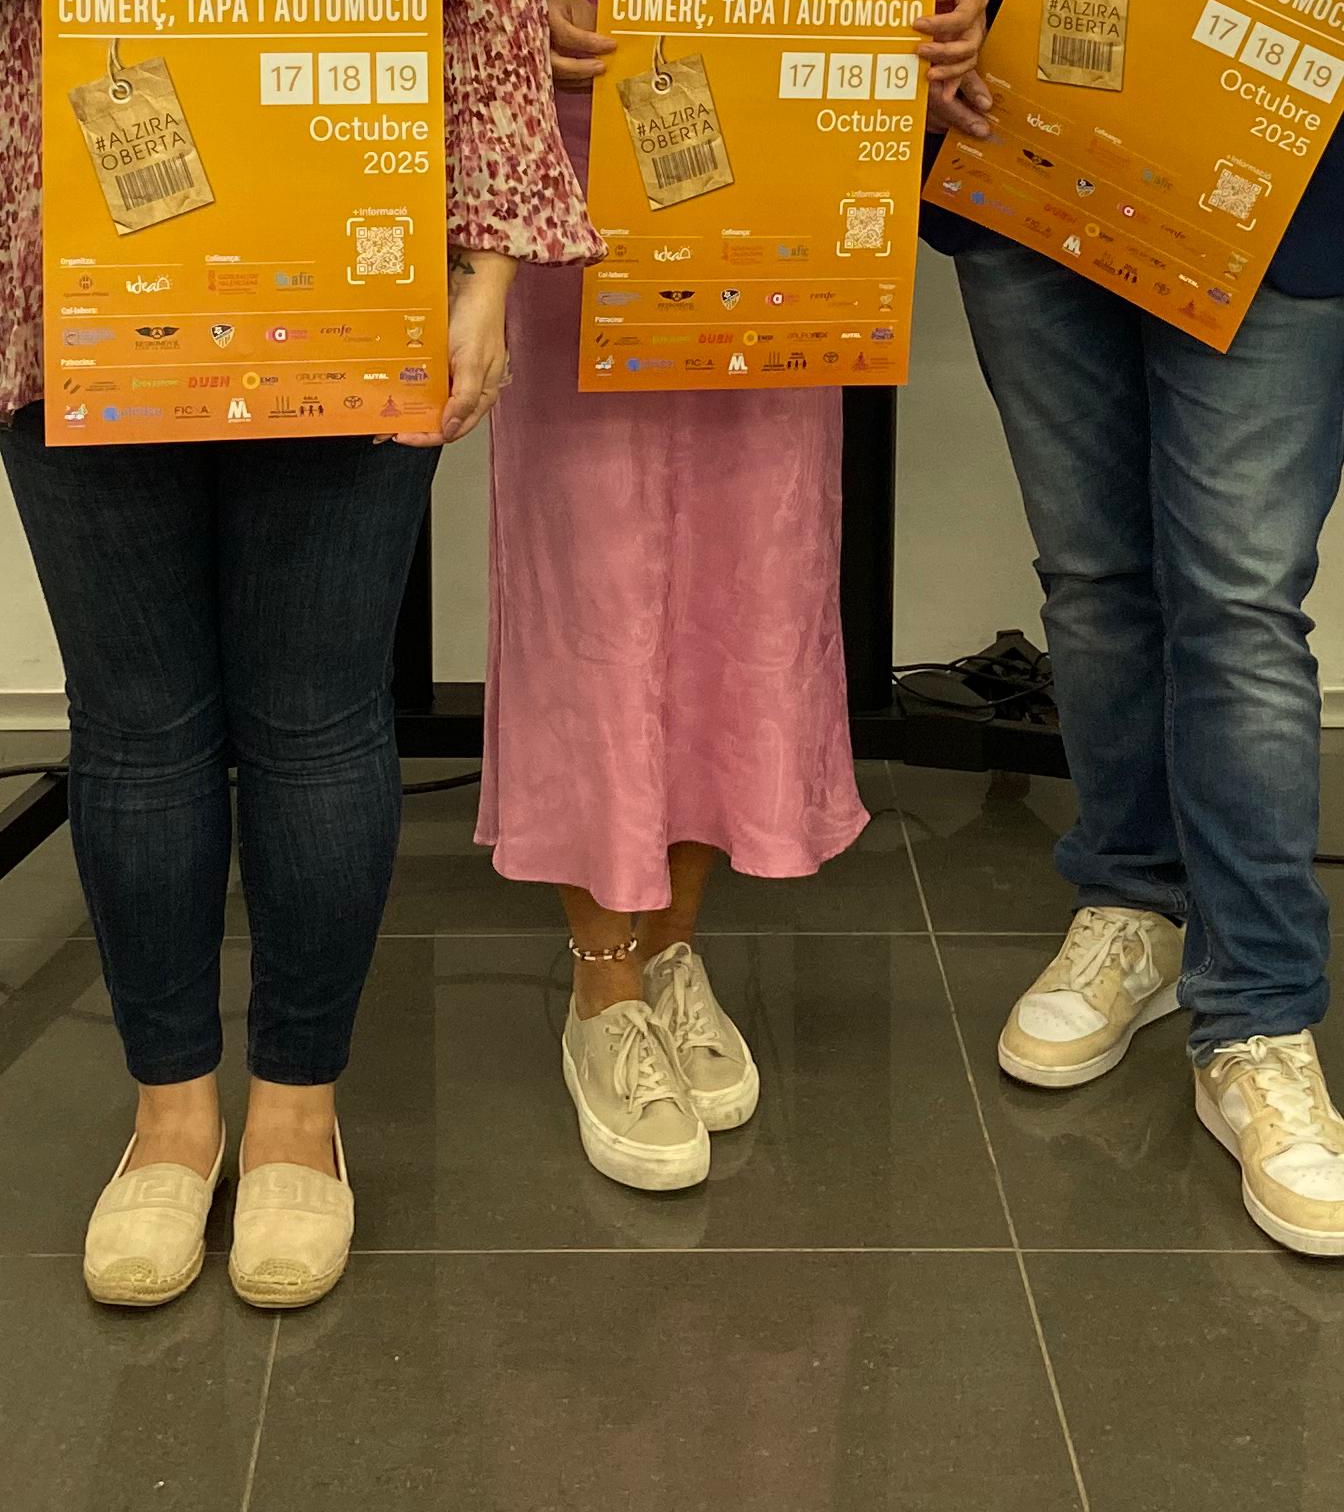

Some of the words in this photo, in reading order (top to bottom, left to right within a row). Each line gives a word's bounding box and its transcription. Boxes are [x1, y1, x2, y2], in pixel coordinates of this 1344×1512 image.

[784, 0, 789, 24] I
[1046, 14, 1120, 37] OBERTA
[1207, 14, 1239, 42] 17
[1253, 38, 1285, 67] 18
[1300, 60, 1333, 88] 19
[270, 66, 302, 92] 17
[329, 66, 360, 91] 18
[385, 65, 417, 90] 19
[789, 65, 815, 88] 17
[837, 65, 863, 88] 18
[884, 66, 909, 88] 19
[1220, 69, 1322, 132] Octubre
[95, 112, 179, 151] #ALZIRA
[309, 115, 428, 141] Octubre
[637, 103, 710, 136] #ALZIRA
[816, 110, 913, 132] Octubre
[641, 120, 714, 153] OBERTA
[1249, 116, 1310, 158] 2025
[101, 132, 186, 171] OBERTA
[364, 152, 428, 174] 2025
[858, 142, 910, 161] 2025
